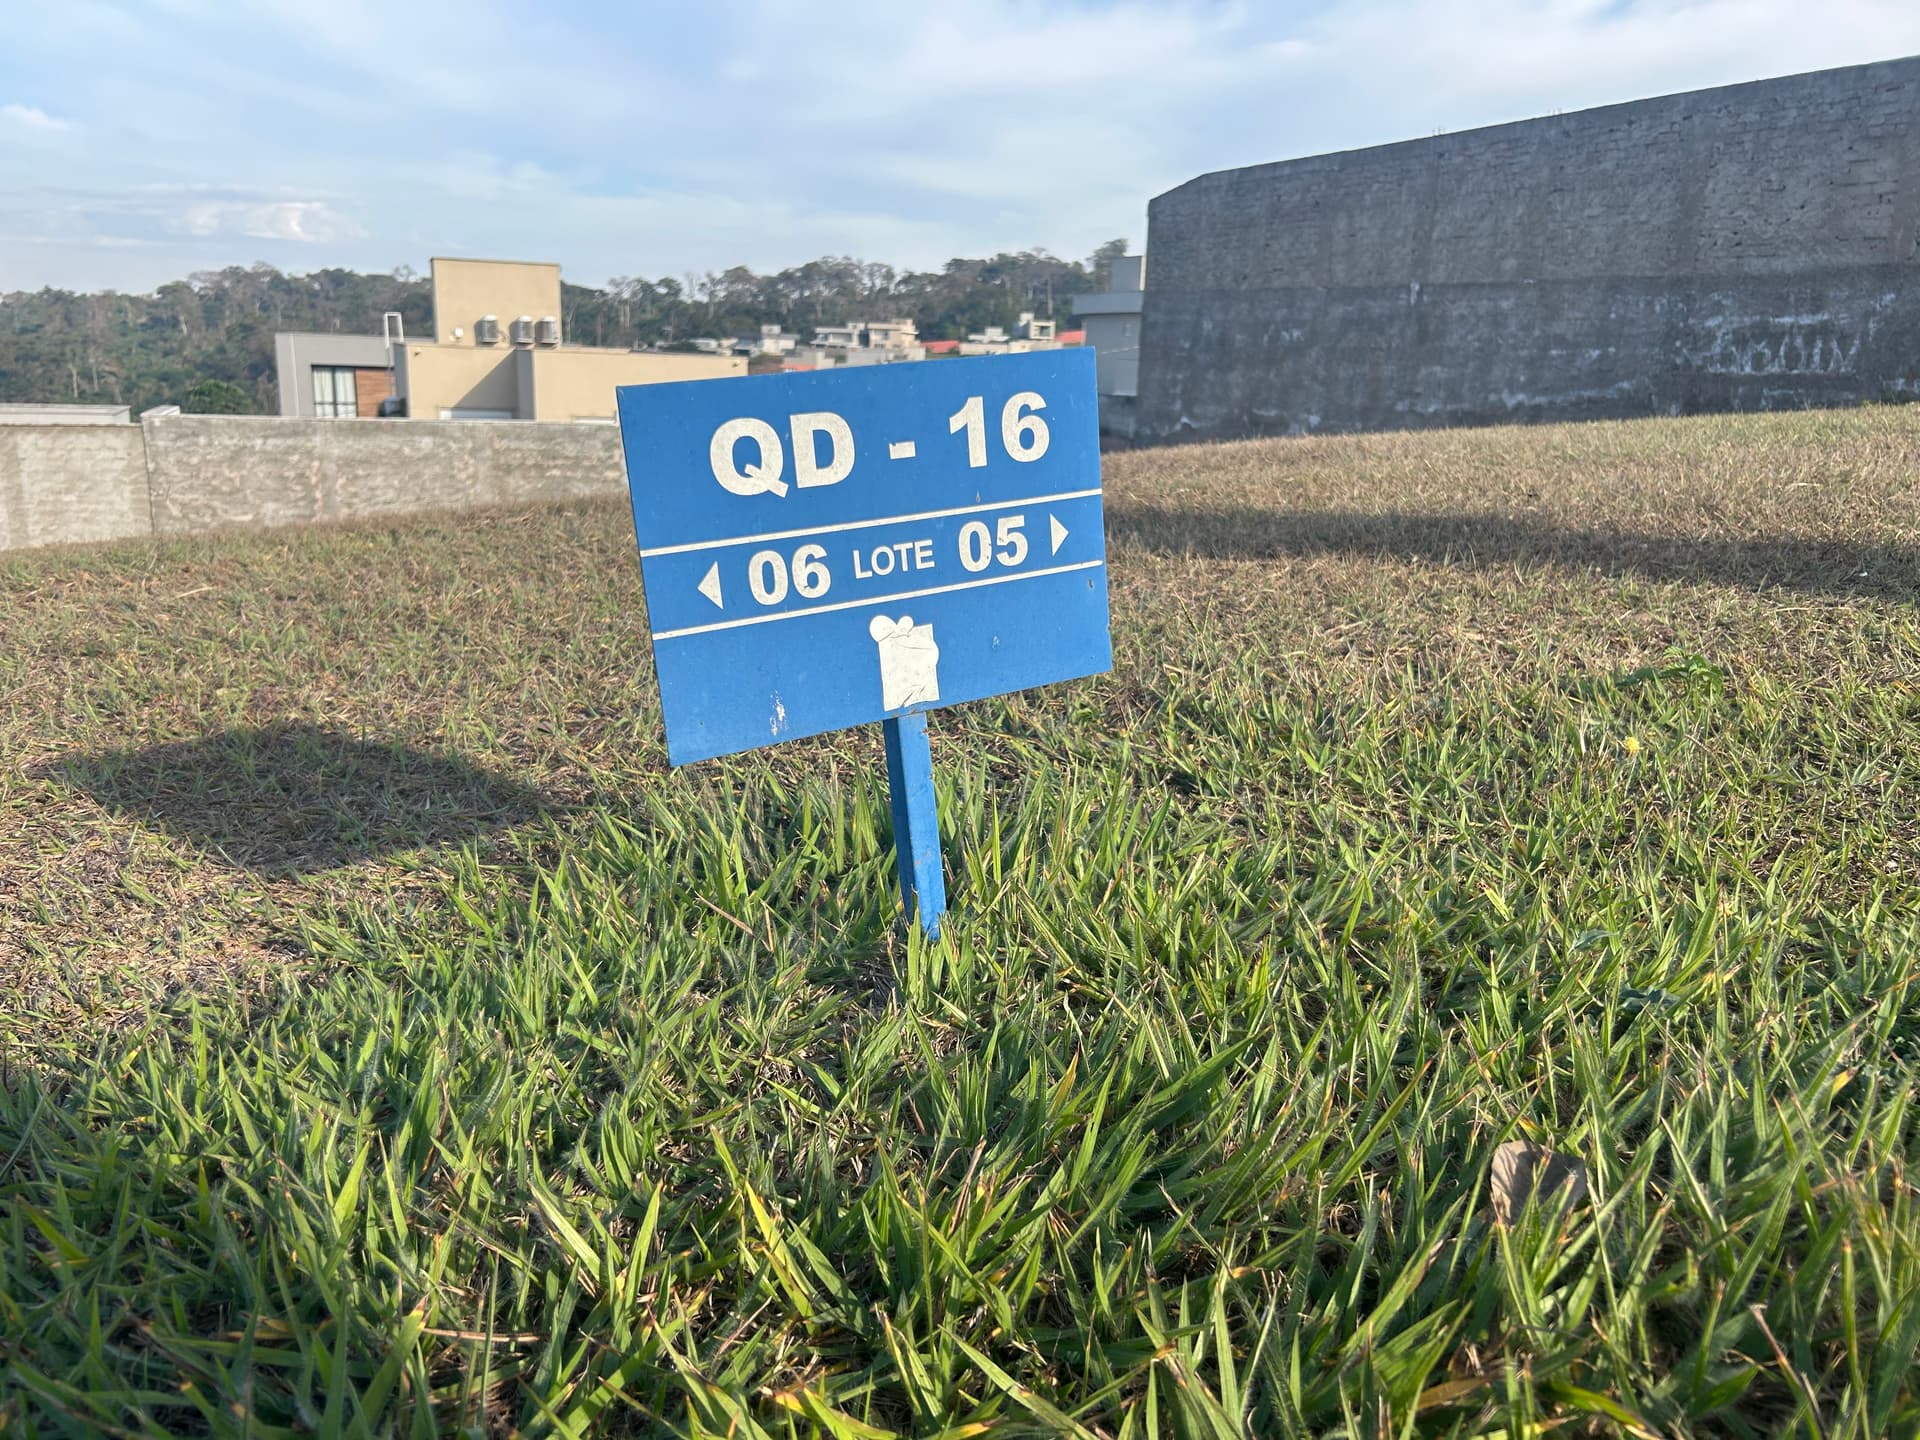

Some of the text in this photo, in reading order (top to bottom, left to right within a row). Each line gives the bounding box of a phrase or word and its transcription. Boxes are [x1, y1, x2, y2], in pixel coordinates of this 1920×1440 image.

[709, 391, 1051, 498] QD - 16
[748, 514, 1030, 606] 06 LOTE 05
